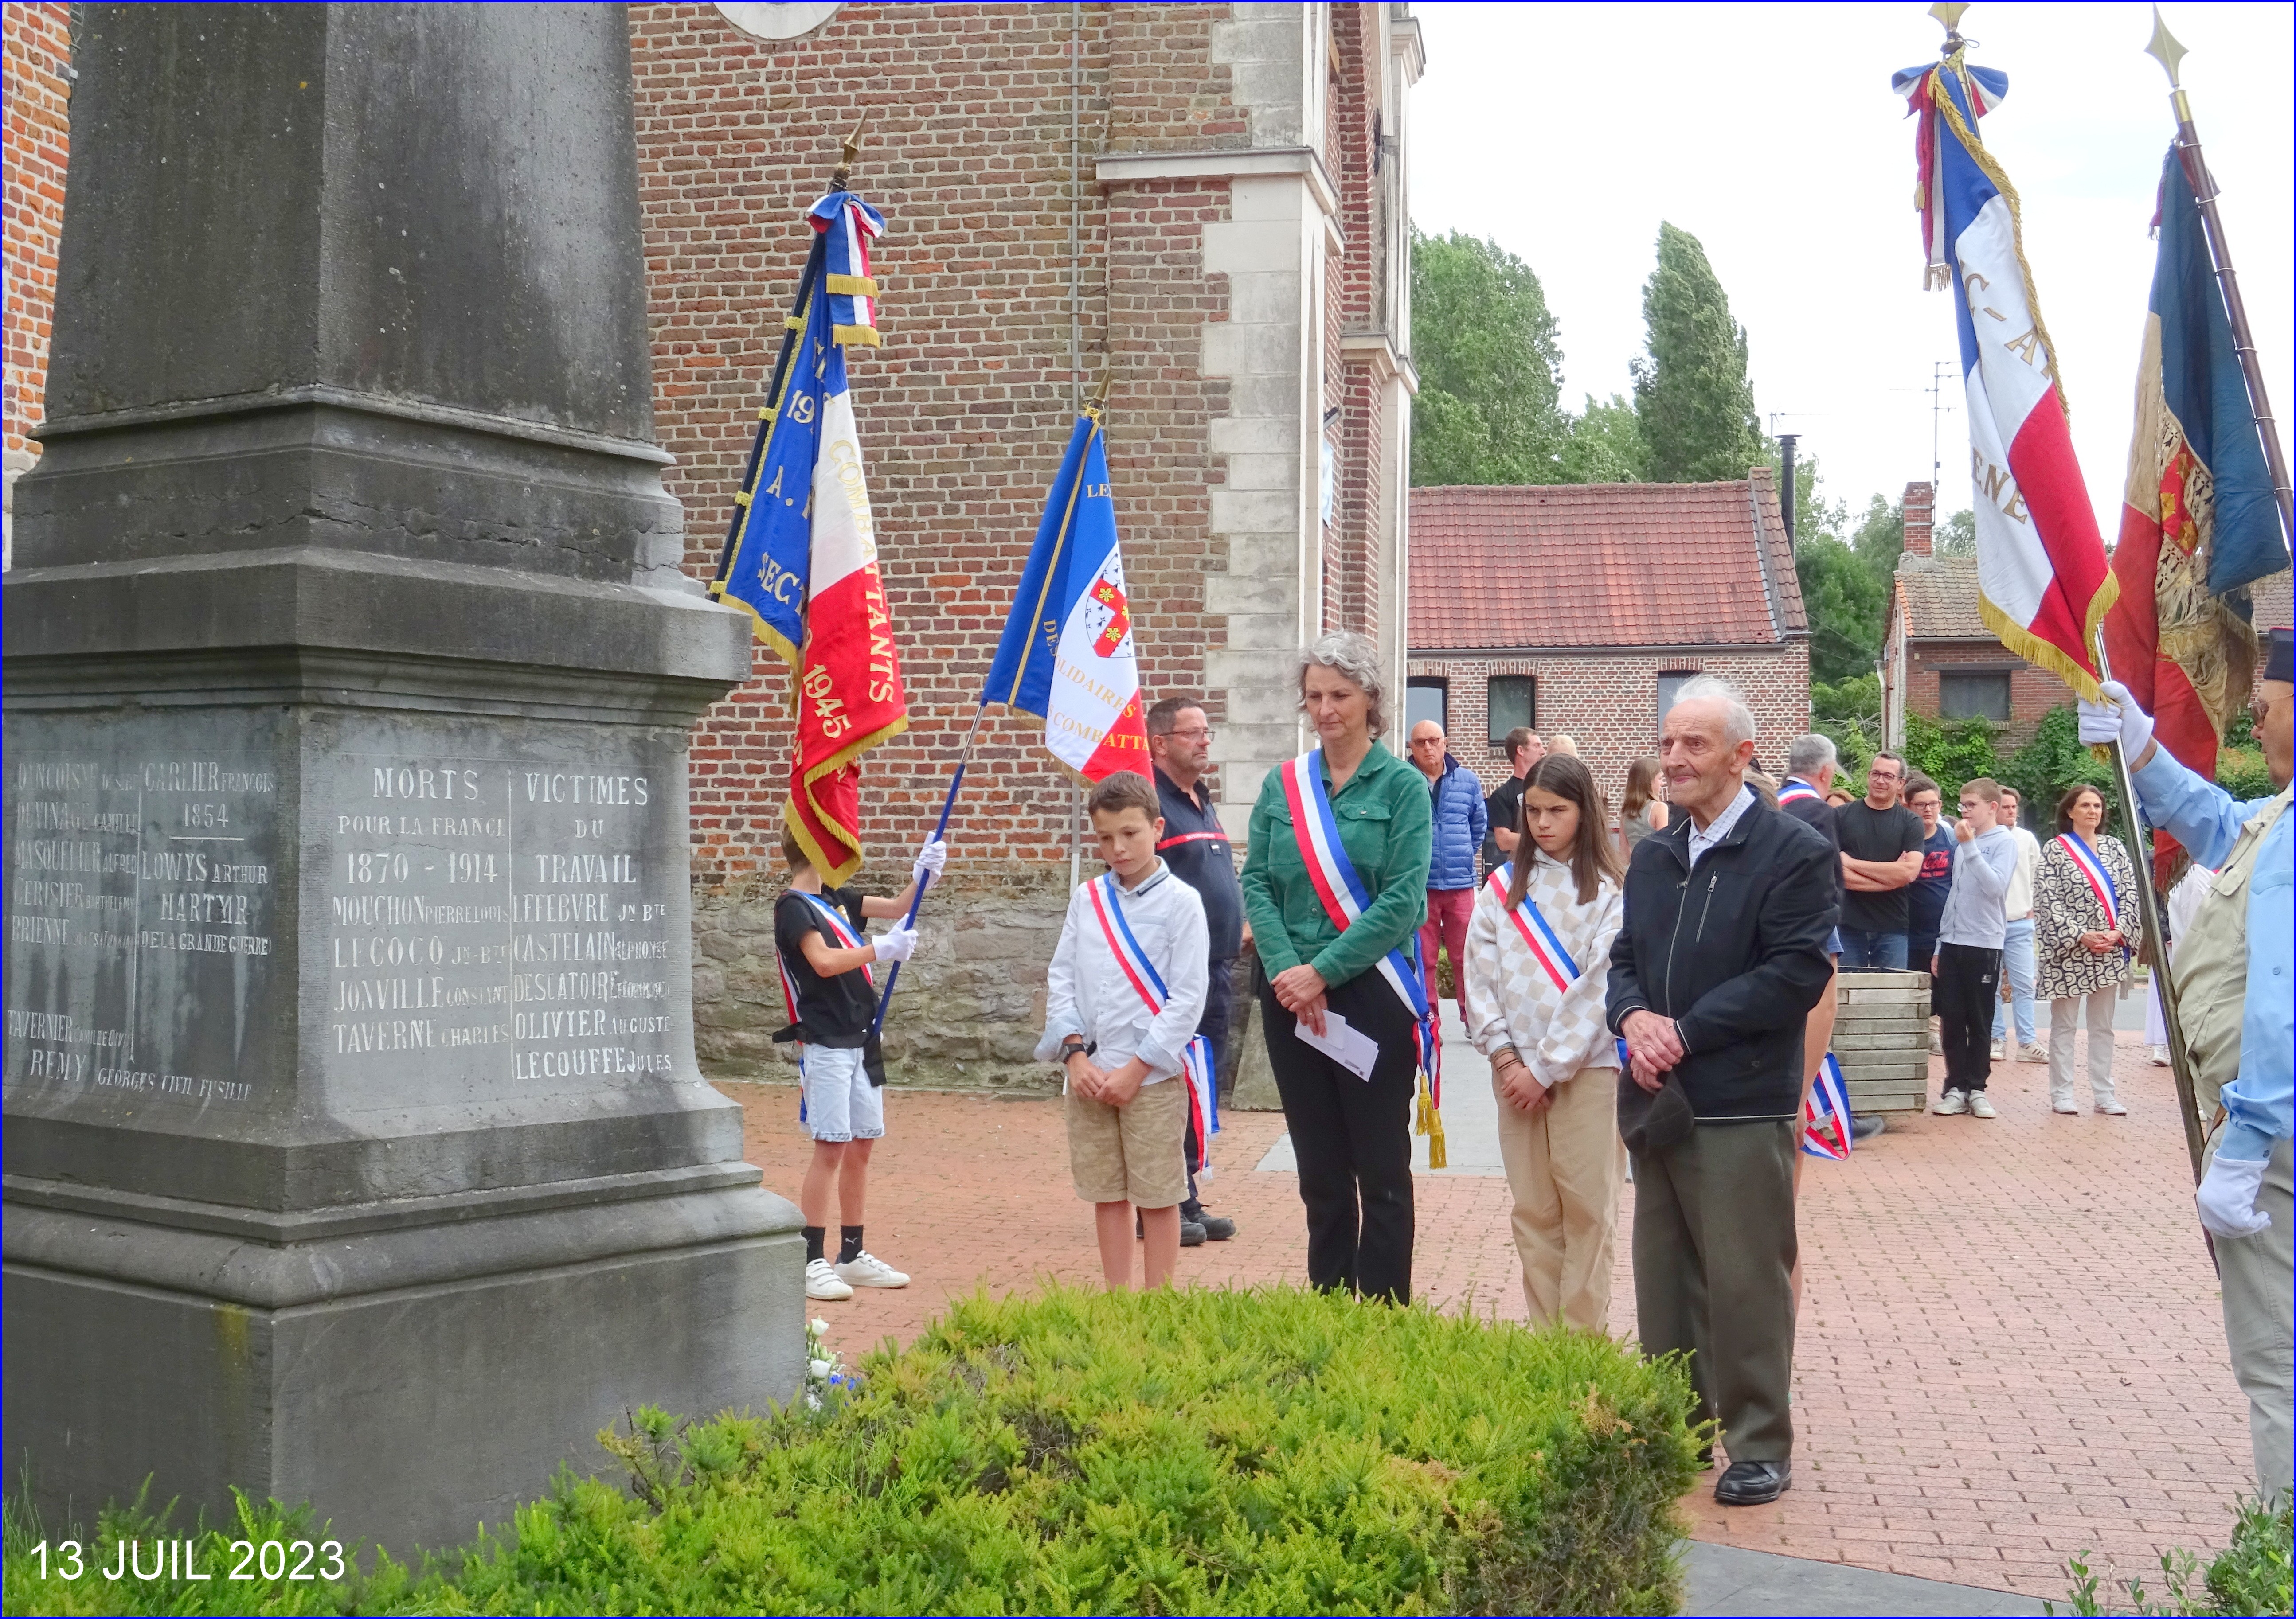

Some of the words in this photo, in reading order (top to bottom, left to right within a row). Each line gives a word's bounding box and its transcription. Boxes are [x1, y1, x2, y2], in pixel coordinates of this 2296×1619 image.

[828, 439, 895, 704] COMBATTANTS
[802, 664, 853, 738] 1945
[145, 761, 219, 792] CARLIER
[372, 767, 479, 800] MORTS
[524, 772, 648, 806] VICTIMES
[184, 803, 229, 828] 1854
[337, 815, 392, 835] POUR
[399, 816, 424, 835] LA
[432, 817, 506, 837] FRANCE
[575, 819, 604, 839] DU
[102, 852, 137, 874] ALFRED
[141, 851, 207, 883] LOWYS
[211, 864, 269, 884] ARTHUR
[348, 852, 409, 884] 1870
[449, 852, 498, 884] 1914
[535, 854, 637, 883] TRAVAIL
[14, 877, 83, 908] CERISIER
[512, 893, 610, 923] LEFEBVRE
[160, 893, 248, 925] MARTYR
[332, 895, 426, 926] MOUCHON
[425, 905, 471, 925] PIERRE
[12, 915, 69, 945] BRIENNE
[160, 932, 176, 949] LA
[179, 932, 227, 953] GRANDE
[513, 931, 615, 962] CASTELAIN
[333, 976, 444, 1012] JONVILLE
[513, 970, 618, 1003] DESCATOIRE
[8, 1010, 73, 1042] TAVERNIER
[333, 1019, 437, 1054] TAVERNE
[442, 1023, 510, 1047] CHARLES
[515, 1009, 606, 1040] OLIVIER
[609, 1016, 670, 1035] AUGUSTE
[29, 1049, 87, 1081] REMY
[98, 1067, 155, 1092] GEORGES
[515, 1047, 626, 1080] LECOUFFE
[626, 1050, 673, 1073] JULES
